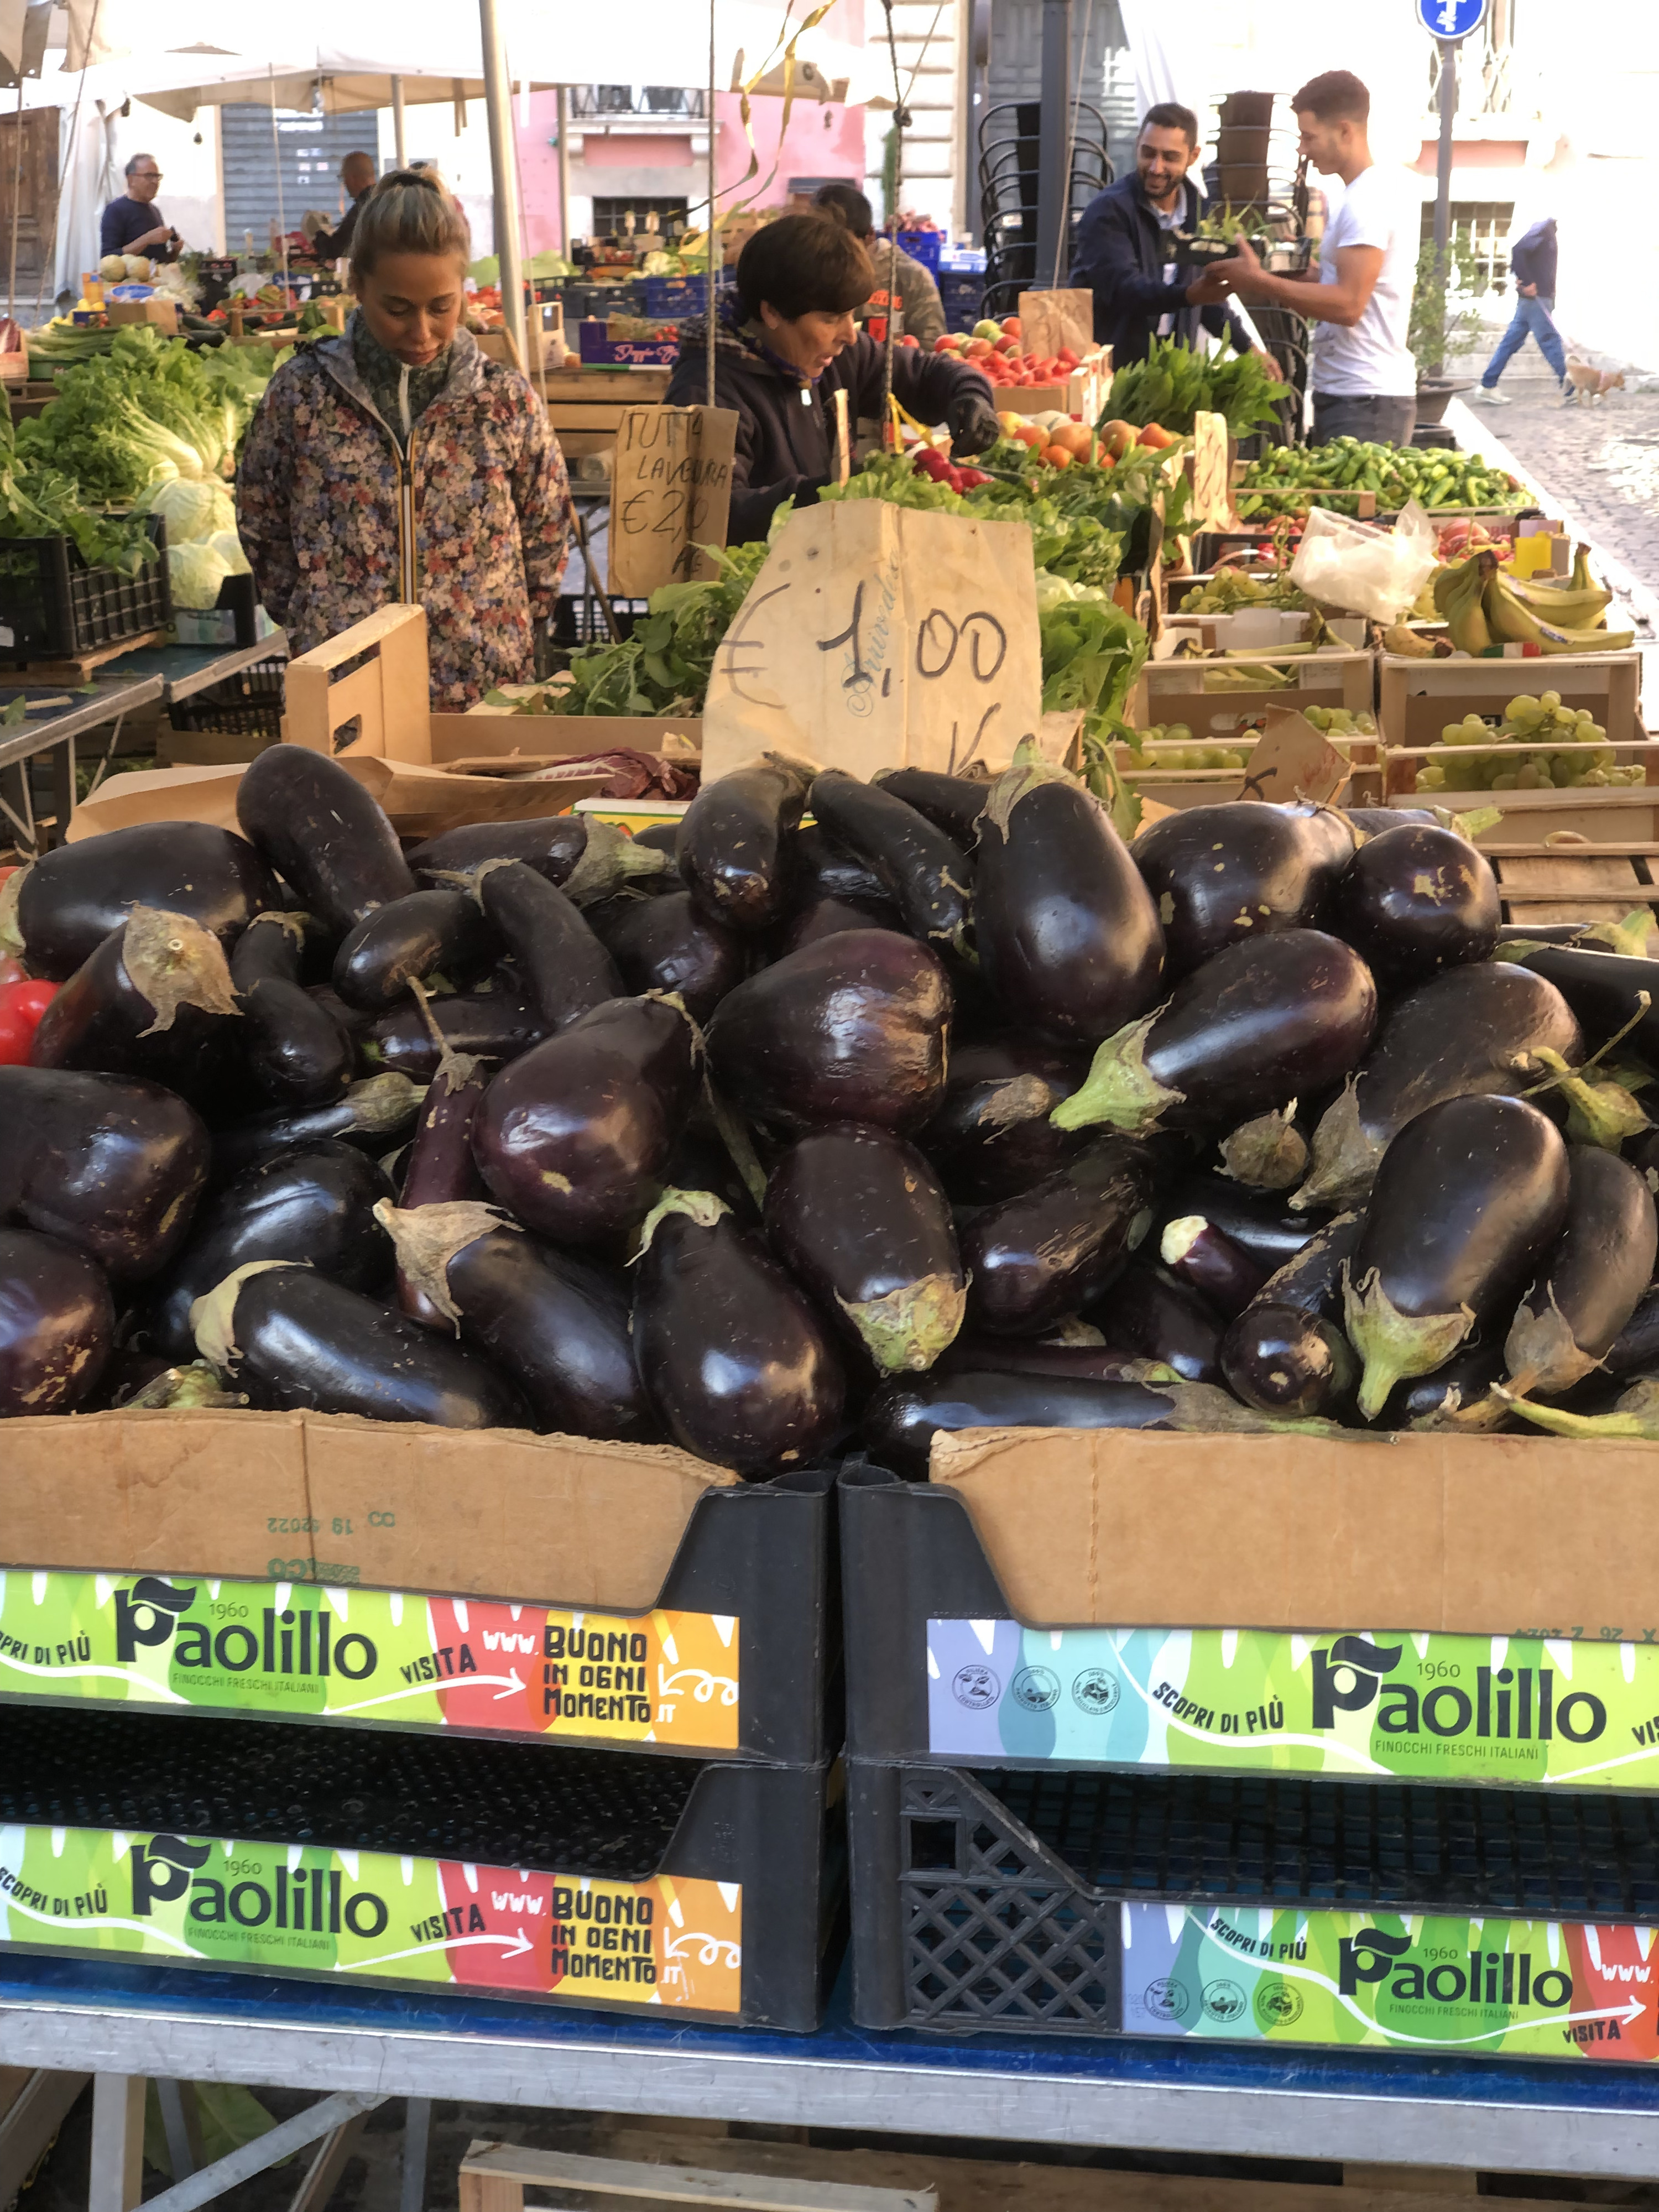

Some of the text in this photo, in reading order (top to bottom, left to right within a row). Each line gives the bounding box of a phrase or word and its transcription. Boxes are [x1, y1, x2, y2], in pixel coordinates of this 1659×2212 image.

[209, 1603, 249, 1620] 1960
[34, 1646, 51, 1665] DI
[56, 1629, 91, 1665] PIÙ
[544, 1626, 647, 1662] BUONO
[399, 1644, 477, 1684] VISITA
[544, 1663, 646, 1692] IN OGNI
[1417, 1661, 1460, 1681] 1960
[544, 1688, 651, 1723] MOMENTO
[1151, 1681, 1215, 1730] SCOPRI
[1220, 1713, 1239, 1734] DI
[1246, 1694, 1284, 1734] PIÙ
[1375, 1740, 1538, 1760] FINOCCHI FRESCHI ITALIANI
[223, 1859, 262, 1875] 1960
[53, 1898, 69, 1916] DI
[74, 1882, 108, 1916] PIÙ
[552, 1887, 653, 1925] BUONO
[410, 1903, 486, 1943] VISITA
[551, 1924, 651, 1954] IN OGNI
[1210, 1918, 1307, 1960] SCOPRI DI PIÙ
[551, 1949, 658, 1984] MOMENTO
[1423, 1947, 1458, 1961] 1960
[1389, 2004, 1519, 2021] FINOCCHI FRESCHI ITALIANI
[1562, 2019, 1621, 2044] VISITA
